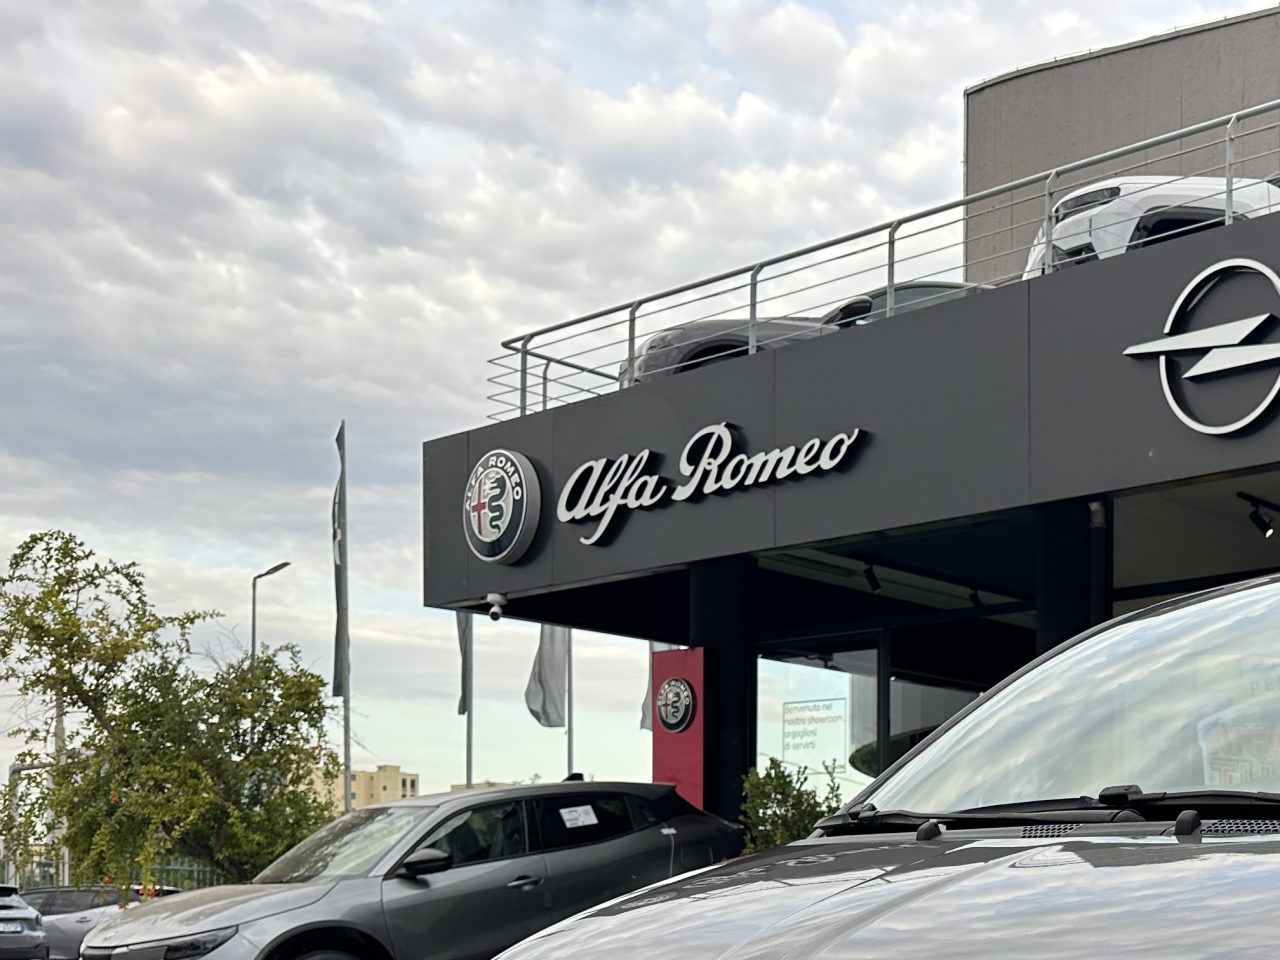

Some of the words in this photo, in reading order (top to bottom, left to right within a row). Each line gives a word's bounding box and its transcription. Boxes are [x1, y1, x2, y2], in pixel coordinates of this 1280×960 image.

[488, 456, 522, 500] ROMEO
[557, 448, 668, 546] Alfa
[671, 421, 859, 501] Romeo
